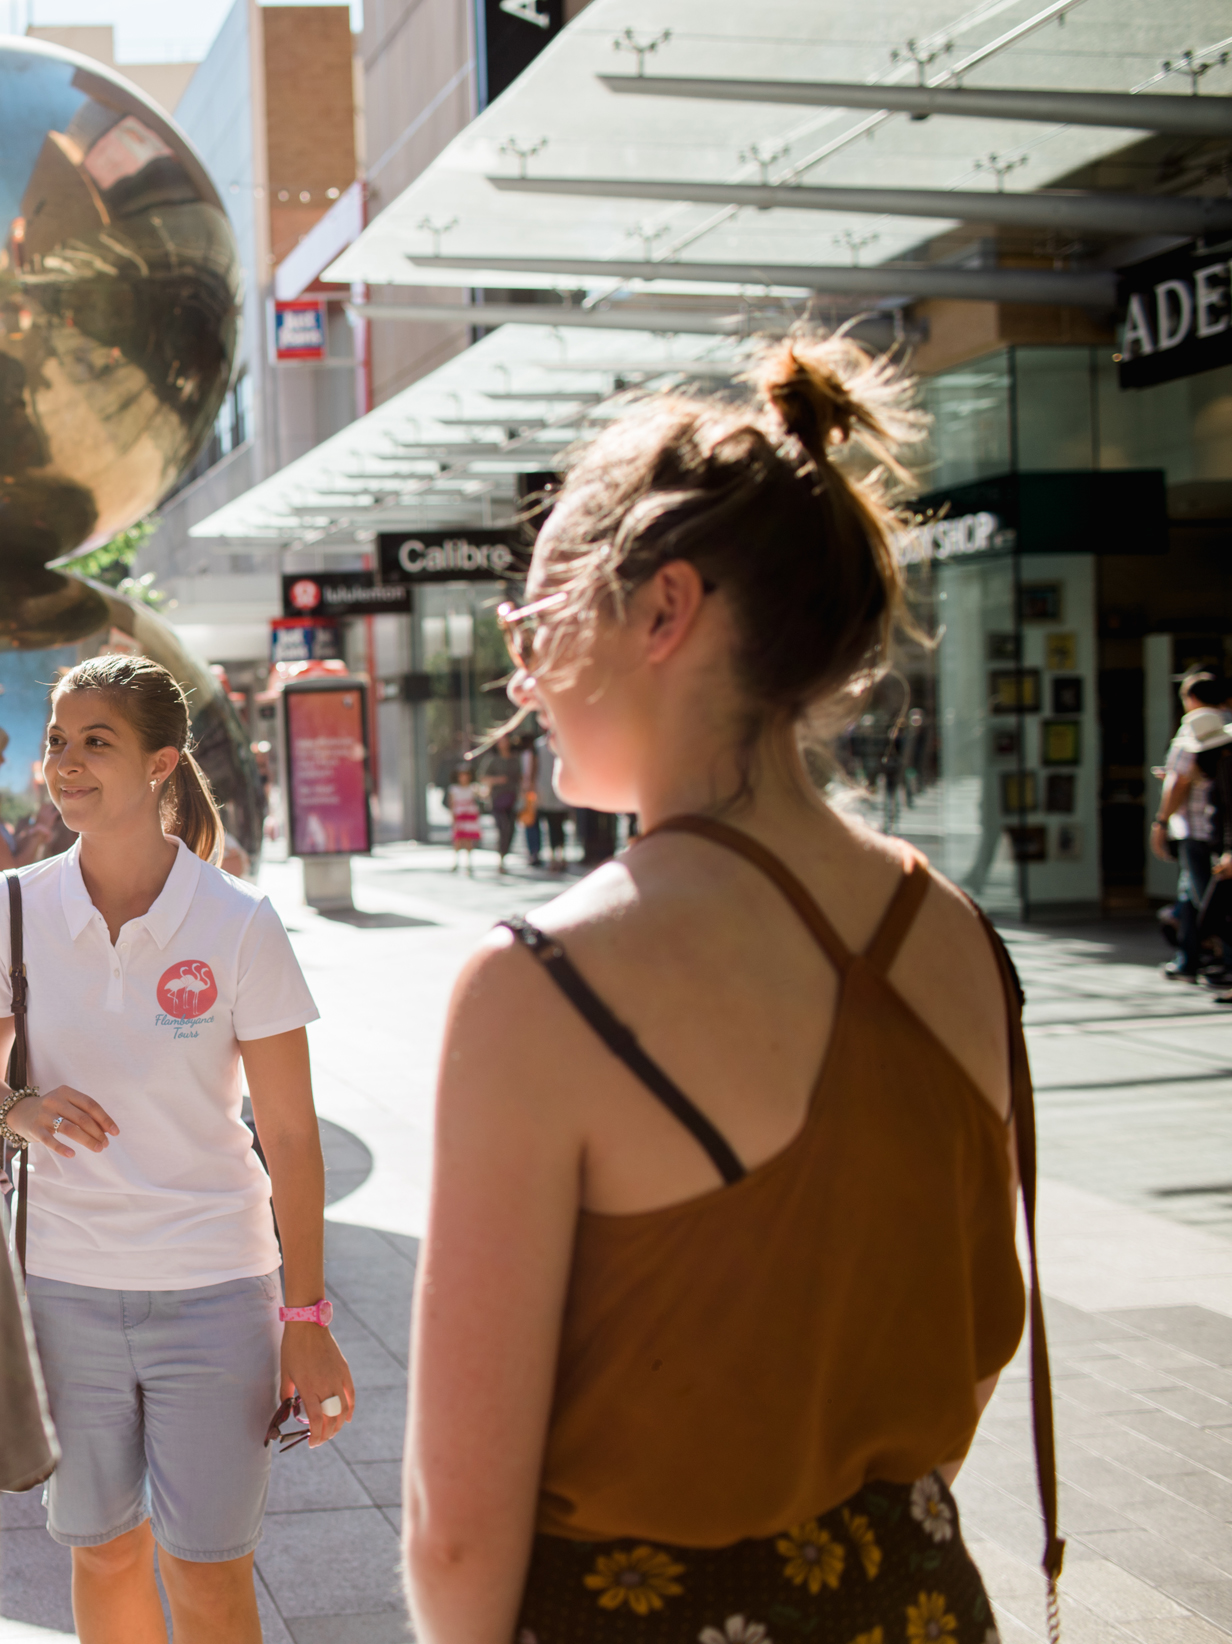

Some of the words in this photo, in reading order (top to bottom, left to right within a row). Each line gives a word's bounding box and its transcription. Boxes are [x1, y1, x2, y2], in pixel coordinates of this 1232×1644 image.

[935, 511, 996, 559] SHOP
[398, 539, 512, 573] Calibre
[173, 1026, 200, 1040] Tours
